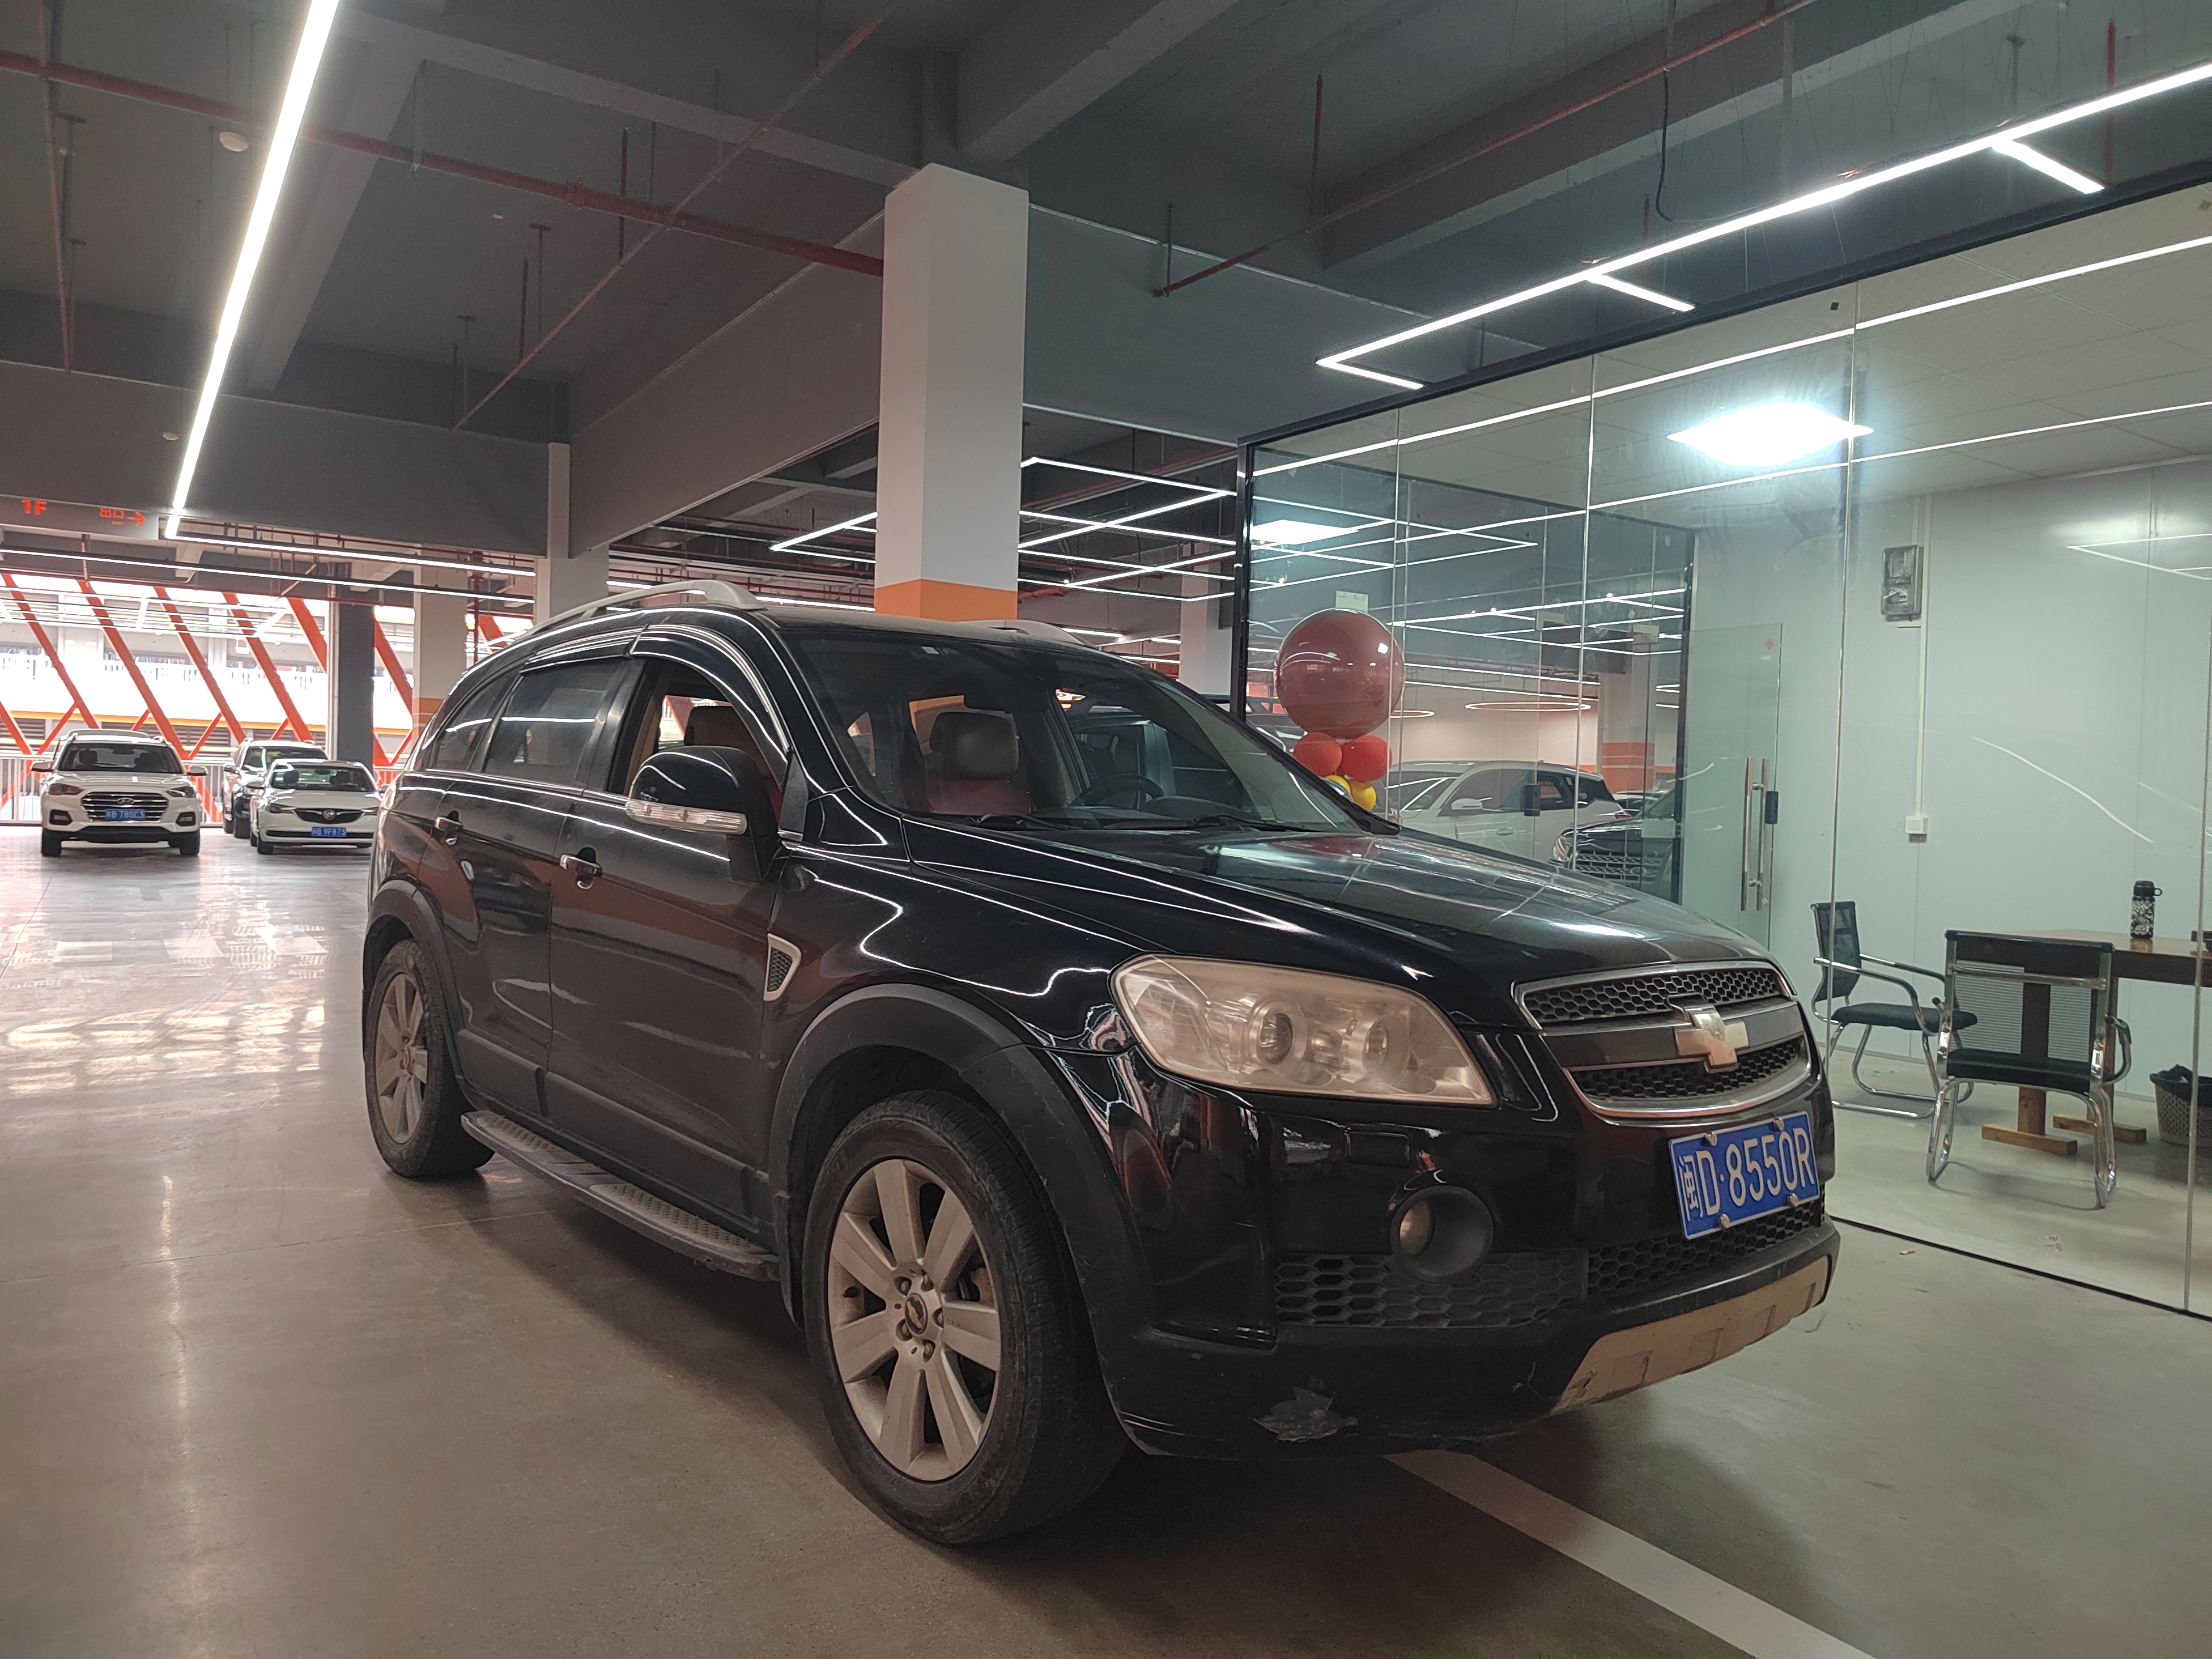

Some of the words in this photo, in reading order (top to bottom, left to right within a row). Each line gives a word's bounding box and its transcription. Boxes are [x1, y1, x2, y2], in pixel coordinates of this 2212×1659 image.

[22, 499, 47, 515] 1F
[100, 508, 124, 519] 出口
[1678, 1127, 1815, 1222] 闽D·8550R
